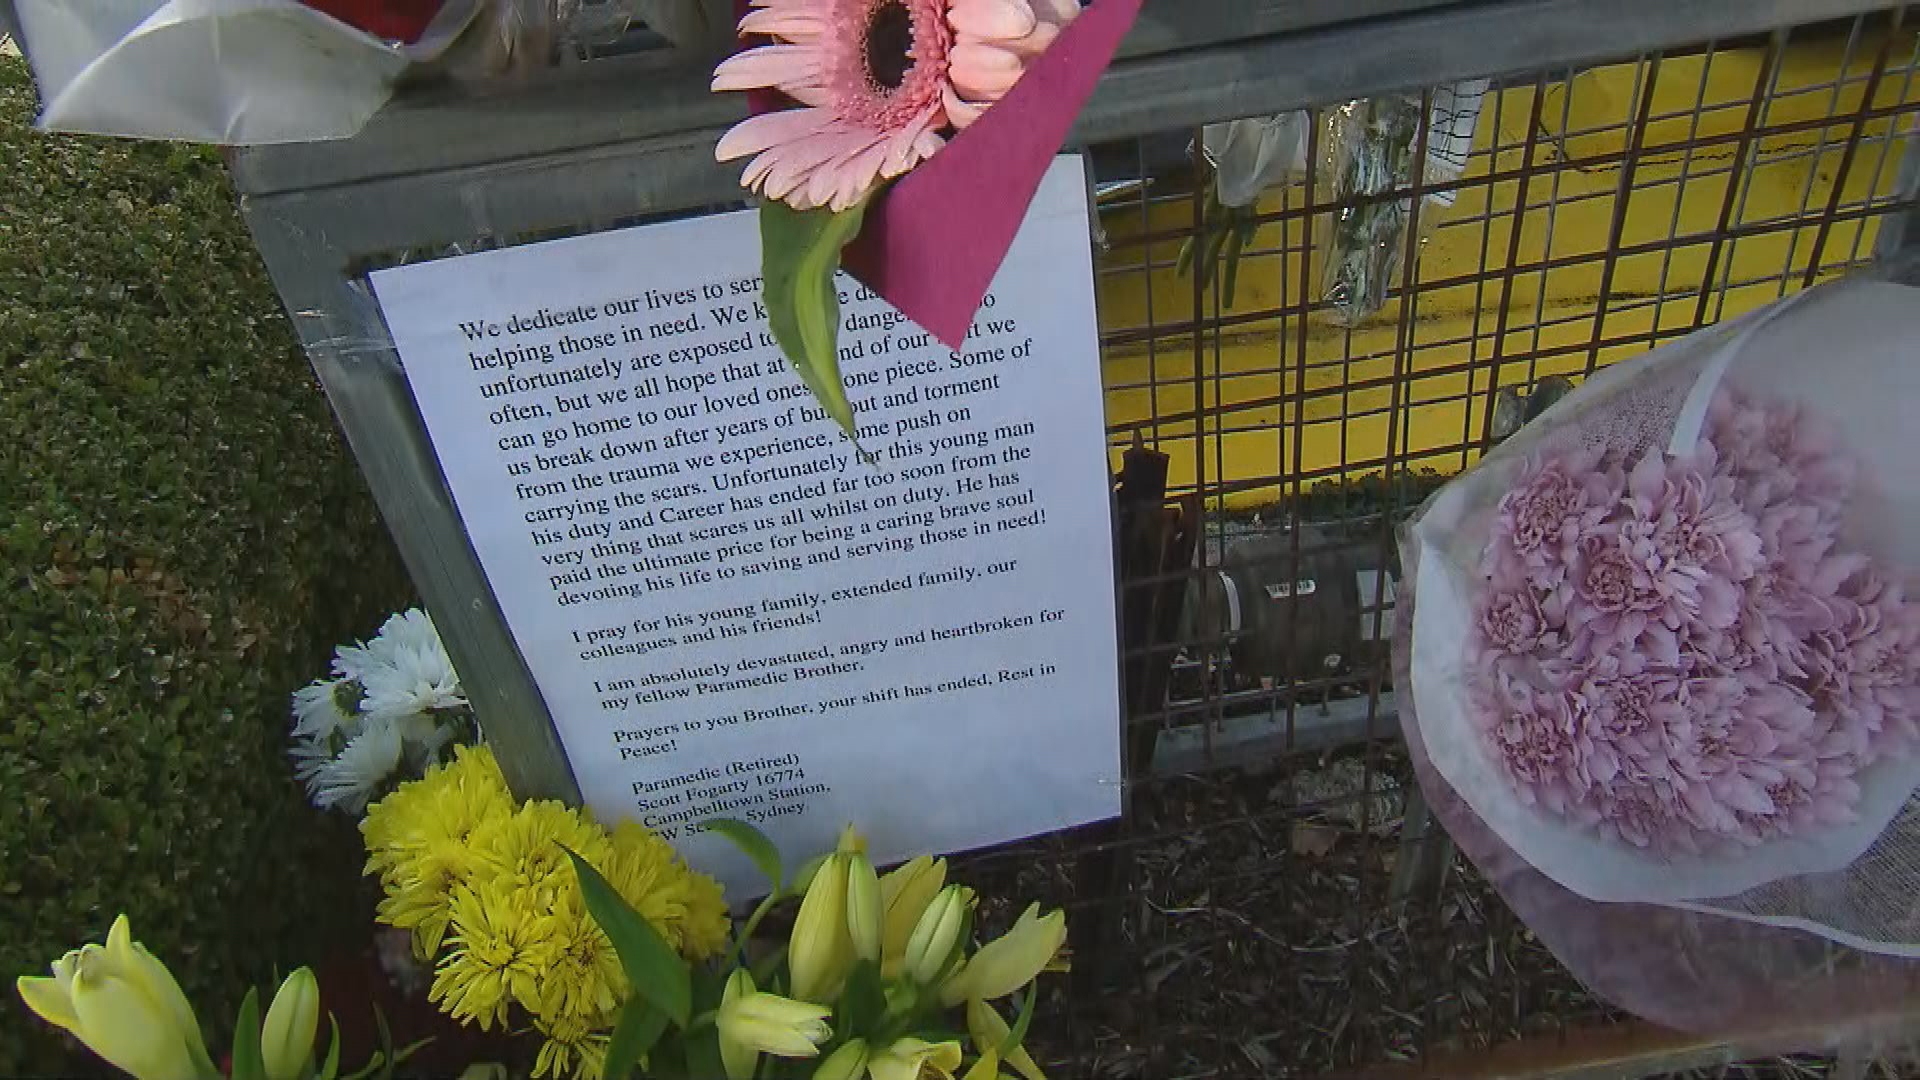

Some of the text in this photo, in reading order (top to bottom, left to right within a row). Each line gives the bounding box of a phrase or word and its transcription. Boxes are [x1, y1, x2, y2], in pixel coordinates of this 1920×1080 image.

[460, 322, 500, 340] We
[507, 306, 598, 334] dedicate
[604, 298, 642, 317] our
[647, 288, 696, 310] lives
[703, 284, 723, 300] to
[471, 344, 554, 370] helping
[558, 332, 616, 354] those
[622, 327, 644, 344] in
[712, 307, 749, 326] We
[480, 360, 622, 398] unfortunately
[630, 354, 663, 370] are
[669, 332, 754, 364] exposed
[846, 310, 910, 331] dange
[979, 294, 996, 308] o
[499, 434, 536, 450] can
[542, 428, 568, 448] go
[573, 416, 632, 438] home
[637, 412, 658, 426] to
[664, 402, 697, 420] our
[702, 386, 760, 414] loved
[766, 383, 812, 402] ones
[843, 370, 879, 388] one
[950, 348, 1005, 370] Some
[1011, 338, 1032, 358] of
[556, 394, 592, 412] but
[596, 388, 628, 405] we
[634, 378, 661, 399] all
[666, 372, 717, 394] hope
[720, 362, 762, 382] that
[767, 358, 786, 374] at
[839, 344, 864, 361] nd
[870, 334, 891, 355] of
[897, 333, 930, 352] our
[984, 320, 1016, 334] we
[507, 462, 531, 476] us
[536, 449, 595, 470] break
[600, 440, 657, 460] down
[663, 428, 709, 448] after
[715, 418, 768, 444] years
[774, 408, 795, 428] of
[883, 386, 918, 408] and
[924, 374, 1000, 400] torment
[516, 481, 567, 500] from
[571, 474, 604, 490] the
[609, 462, 680, 486] trauma
[685, 454, 715, 470] we
[895, 411, 941, 438] push
[947, 408, 971, 422] on
[525, 498, 610, 524] carrying
[614, 492, 645, 508] the
[713, 454, 847, 490] Unfortunately
[888, 440, 923, 460] this
[929, 432, 988, 456] young
[995, 422, 1034, 440] man
[531, 447, 1030, 546] his duty and Career has ended far too soon from the
[541, 550, 583, 566] very
[589, 540, 643, 558] thing
[647, 532, 685, 548] that
[689, 522, 748, 542] scares
[753, 518, 776, 530] us
[781, 508, 805, 526] all
[807, 500, 869, 522] whilst
[873, 496, 897, 510] on
[957, 479, 983, 495] He
[989, 472, 1019, 488] has
[550, 488, 1034, 590] paid the ultimate price for being a caring brave soul
[558, 508, 1045, 606] devoting his life to saving and serving those in need!
[580, 610, 821, 660] colleagues and his friends!
[586, 626, 628, 644] pray
[632, 620, 660, 634] for
[665, 614, 693, 628] his
[698, 606, 757, 626] young
[832, 575, 912, 601] extended
[987, 560, 1017, 574] our
[602, 696, 629, 710] my
[634, 686, 690, 705] fellow
[696, 671, 789, 695] Paramedic
[608, 680, 638, 694] am
[641, 664, 730, 688] absolutely
[840, 640, 888, 656] angry
[895, 630, 925, 646] and
[931, 616, 1033, 640] heartbroken
[1040, 610, 1064, 622] for
[613, 724, 679, 745] Prayers
[684, 722, 701, 730] to
[706, 716, 738, 730] you
[818, 696, 857, 714] your
[862, 688, 900, 704] shift
[904, 686, 932, 698] has
[998, 668, 1034, 682] Rest
[1040, 664, 1055, 676] in
[620, 739, 677, 760] Peace!
[632, 754, 799, 794] Paramedic (Retired)
[638, 768, 804, 812] Scott Fogarty 16774
[643, 796, 764, 829] Campbelltown
